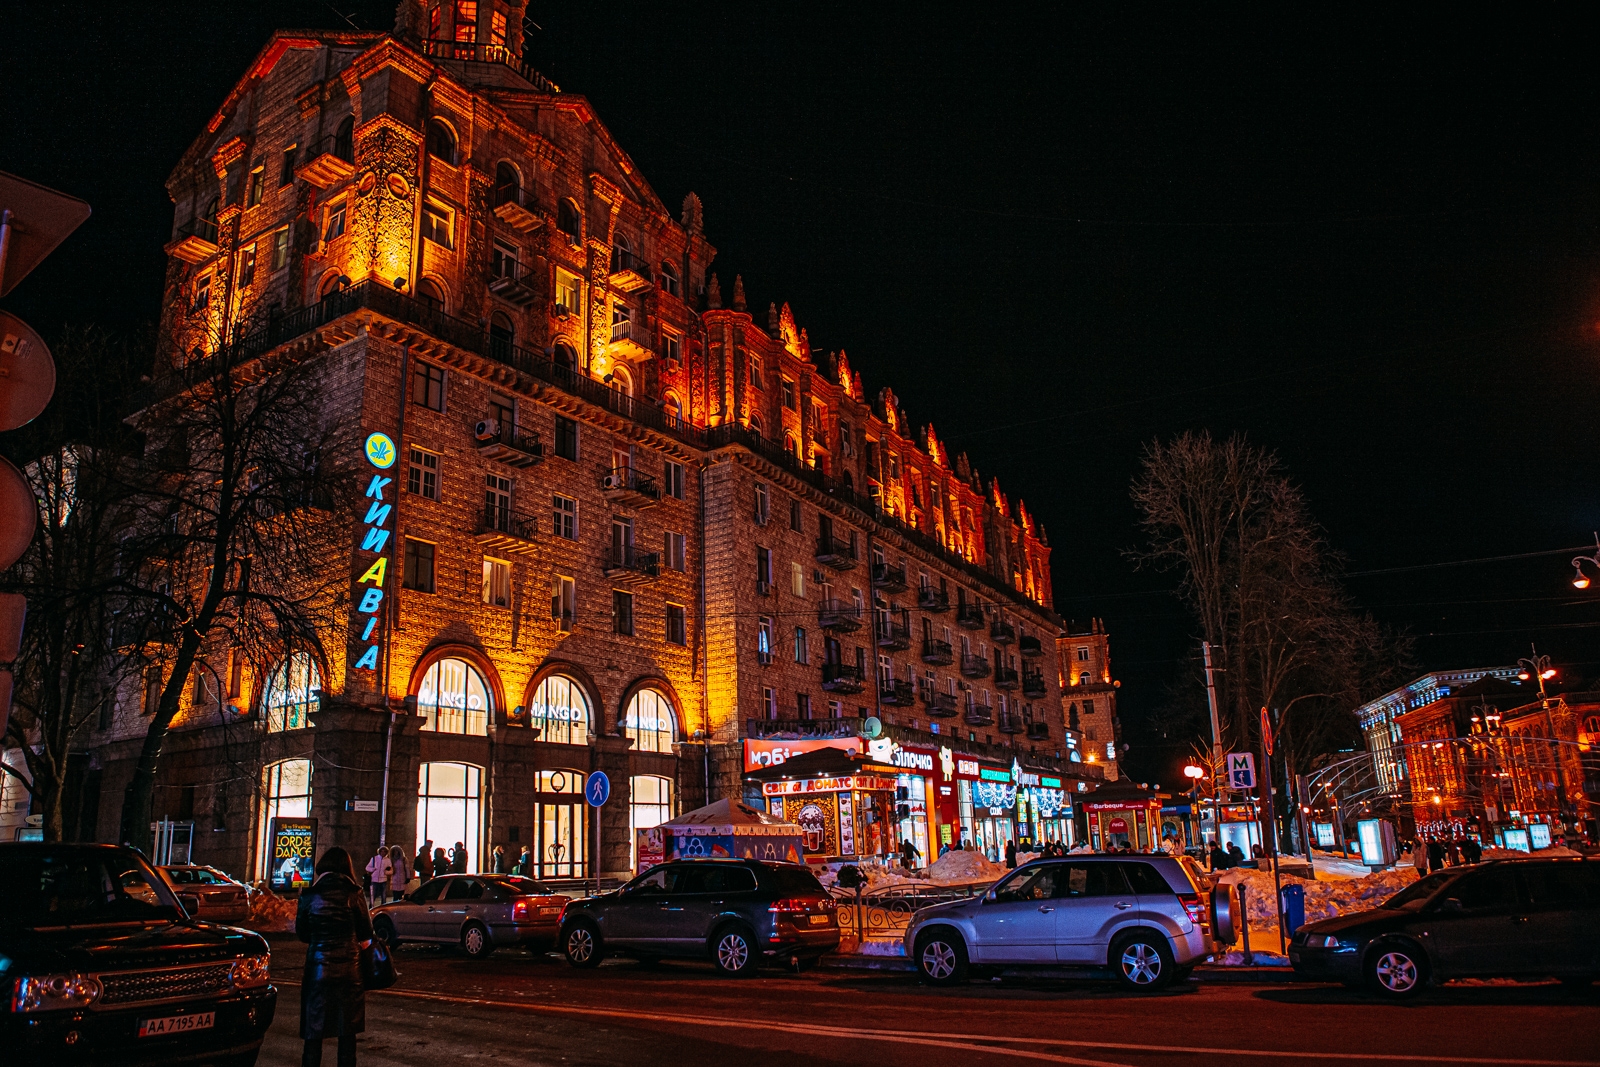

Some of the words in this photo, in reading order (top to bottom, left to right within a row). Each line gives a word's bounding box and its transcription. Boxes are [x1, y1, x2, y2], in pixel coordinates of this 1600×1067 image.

[276, 836, 304, 849] LORD
[275, 847, 313, 858] DANCE
[148, 1020, 165, 1033] AA
[168, 1016, 194, 1031] 7195
[196, 1014, 211, 1027] AA
